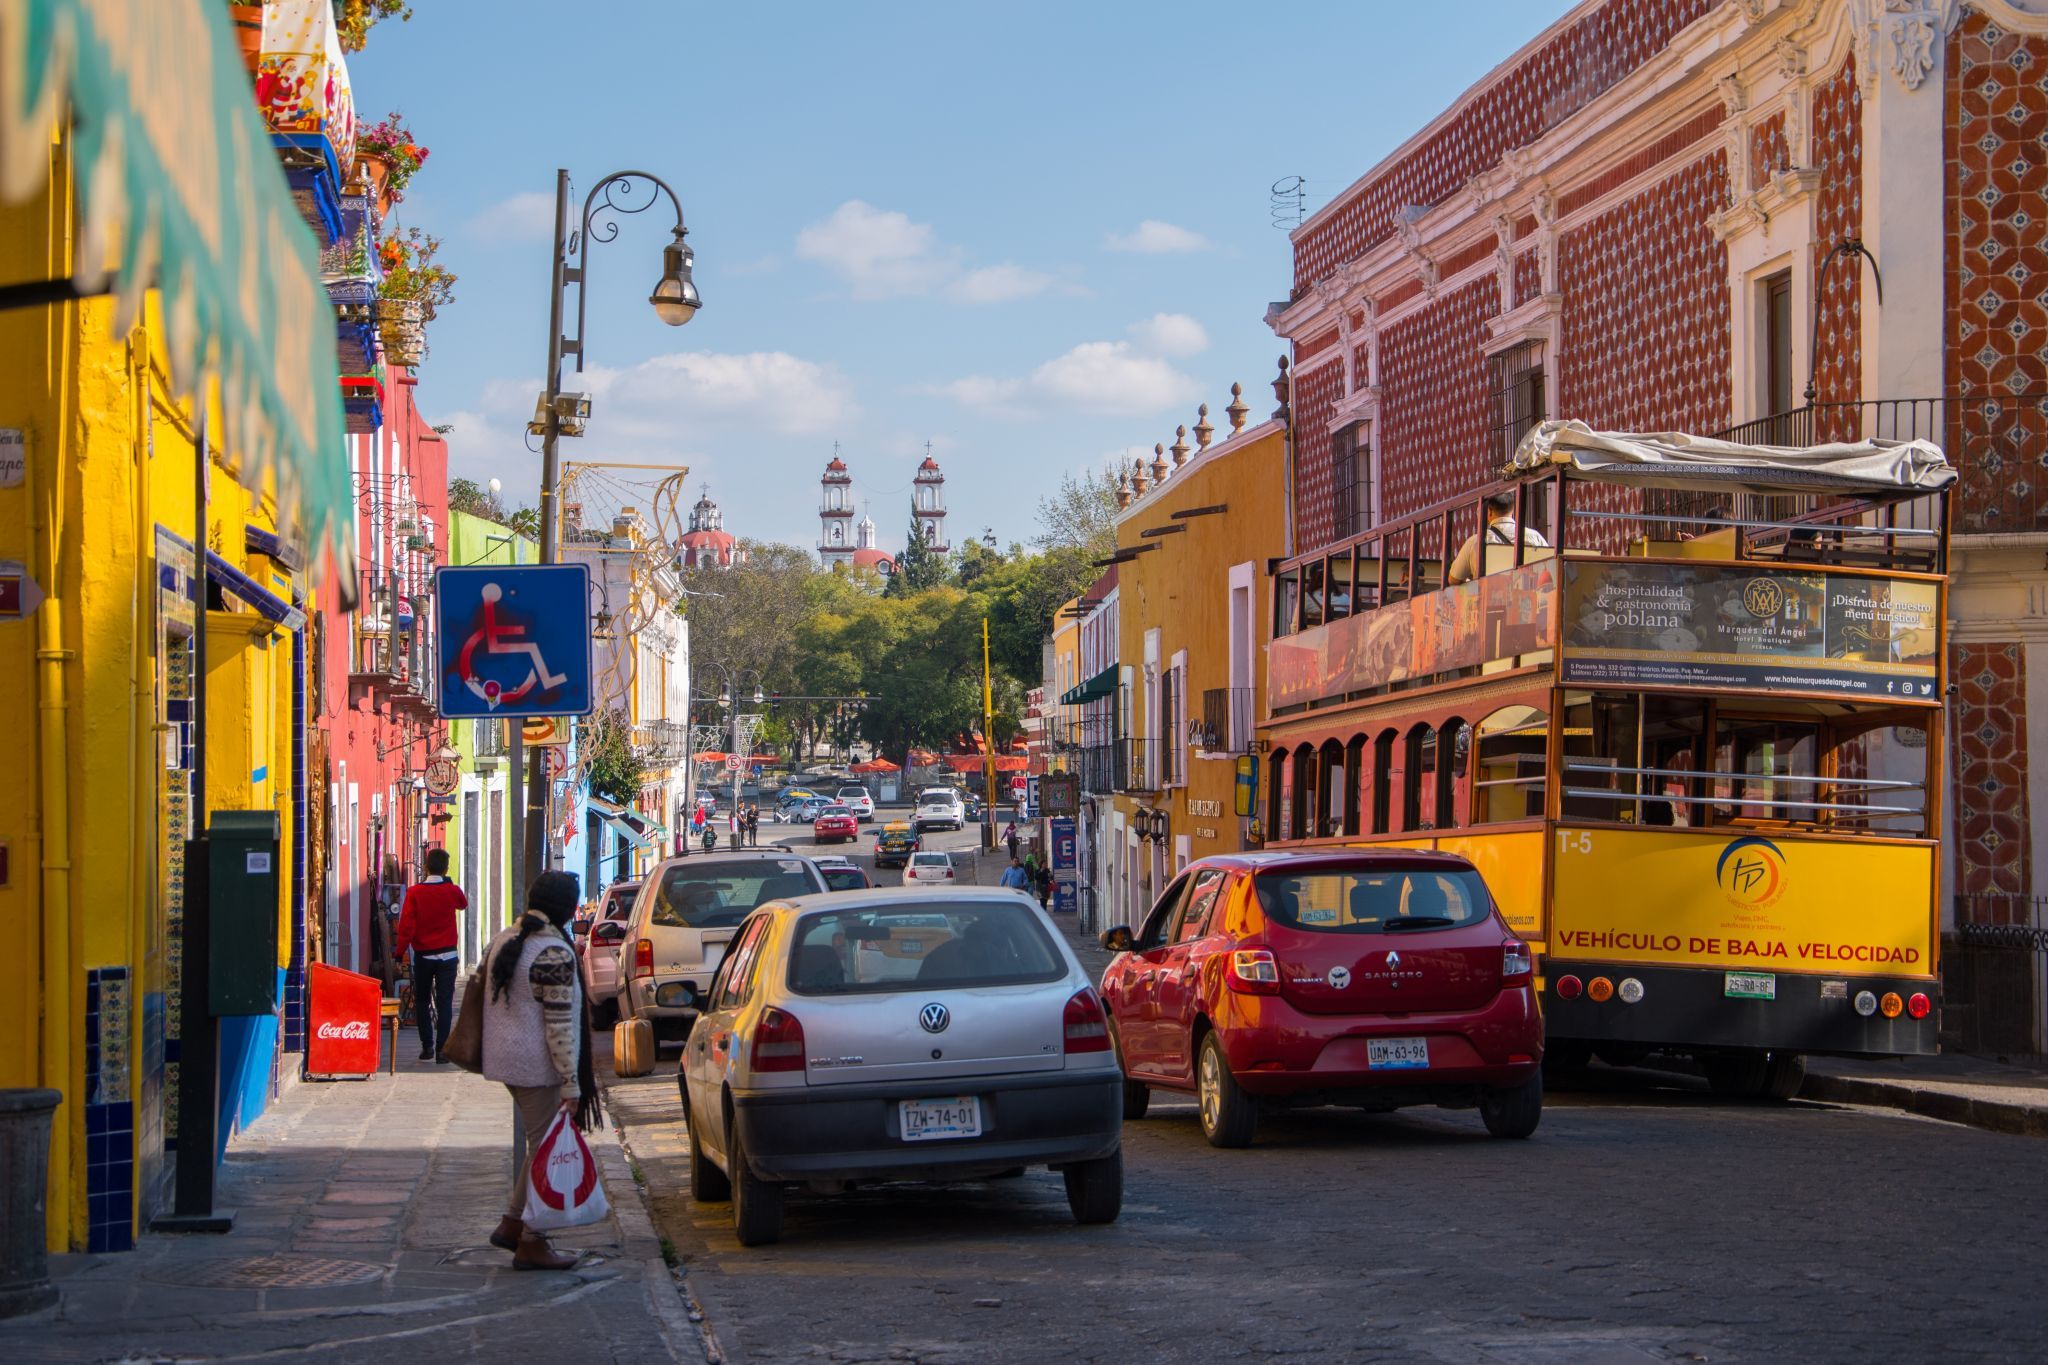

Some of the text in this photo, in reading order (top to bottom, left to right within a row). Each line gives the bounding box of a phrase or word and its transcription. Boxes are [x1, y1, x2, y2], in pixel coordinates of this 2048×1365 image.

[1605, 583, 1684, 598] hospitalidad
[1596, 594, 1691, 612] & gastronomía
[1832, 594, 1932, 613] ¡Disfruta de nuestro
[1603, 609, 1679, 631] poblana
[1844, 608, 1920, 624] menú turístico!
[1764, 675, 1868, 689] www.hotelmarquesdelangel.com
[1062, 840, 1072, 857] E
[1557, 830, 1593, 854] T-5
[1558, 928, 1920, 964] VEHÍCULO DE BAJA VELOCIDAD
[1364, 970, 1423, 979] SANDERO
[317, 1021, 371, 1040] Coca-Cola
[1370, 1045, 1426, 1060] UAM-63-96
